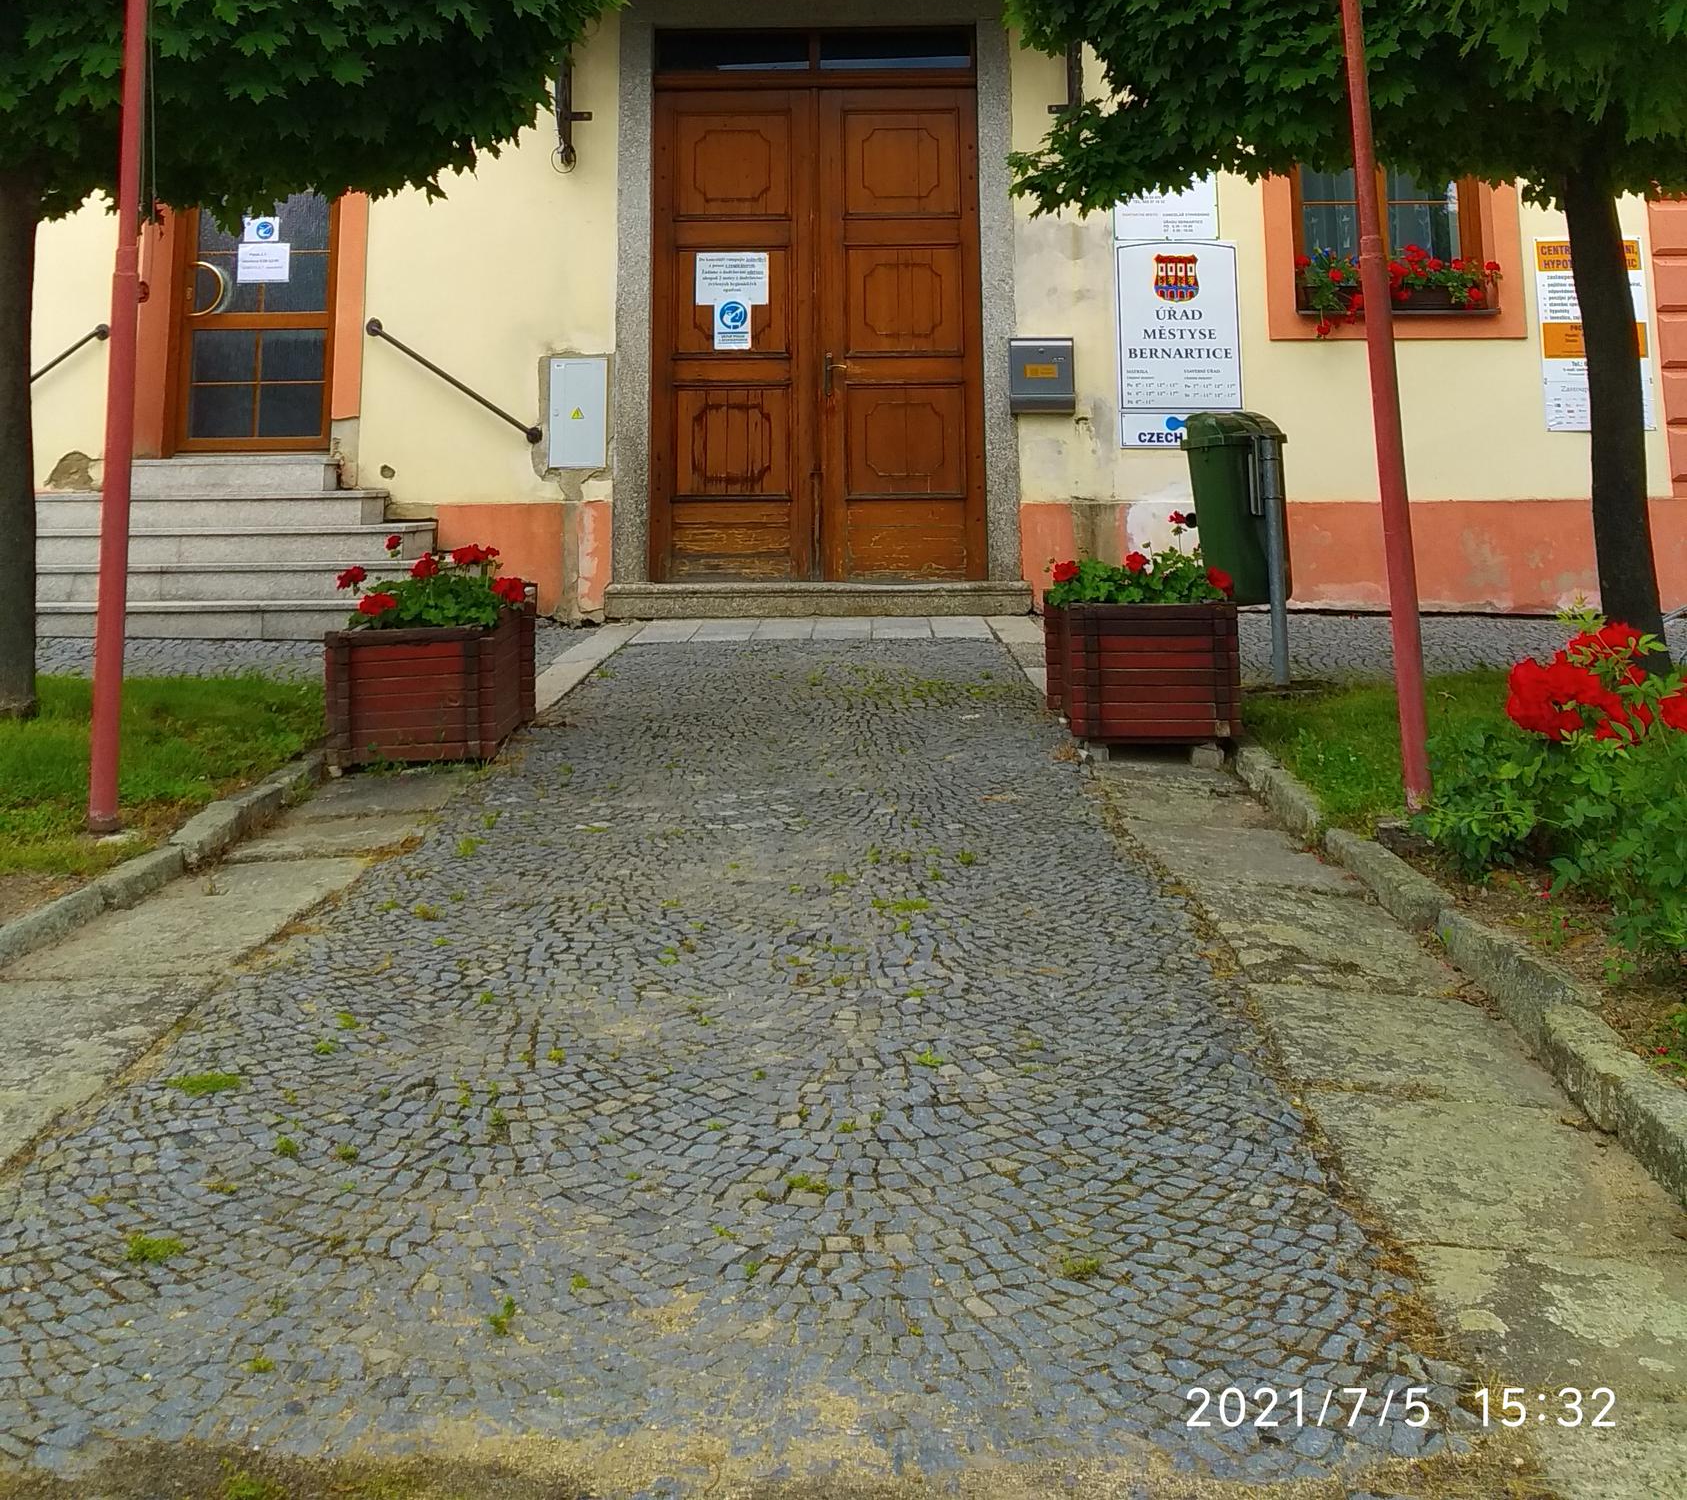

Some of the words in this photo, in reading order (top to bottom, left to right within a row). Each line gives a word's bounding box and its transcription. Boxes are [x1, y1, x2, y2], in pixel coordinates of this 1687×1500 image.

[1540, 245, 1571, 256] CENTR
[1155, 306, 1203, 321] ÚŘAD
[1143, 325, 1217, 340] MĚSTYSE
[1128, 348, 1233, 360] BERNARTICE
[1137, 432, 1183, 444] CZECH
